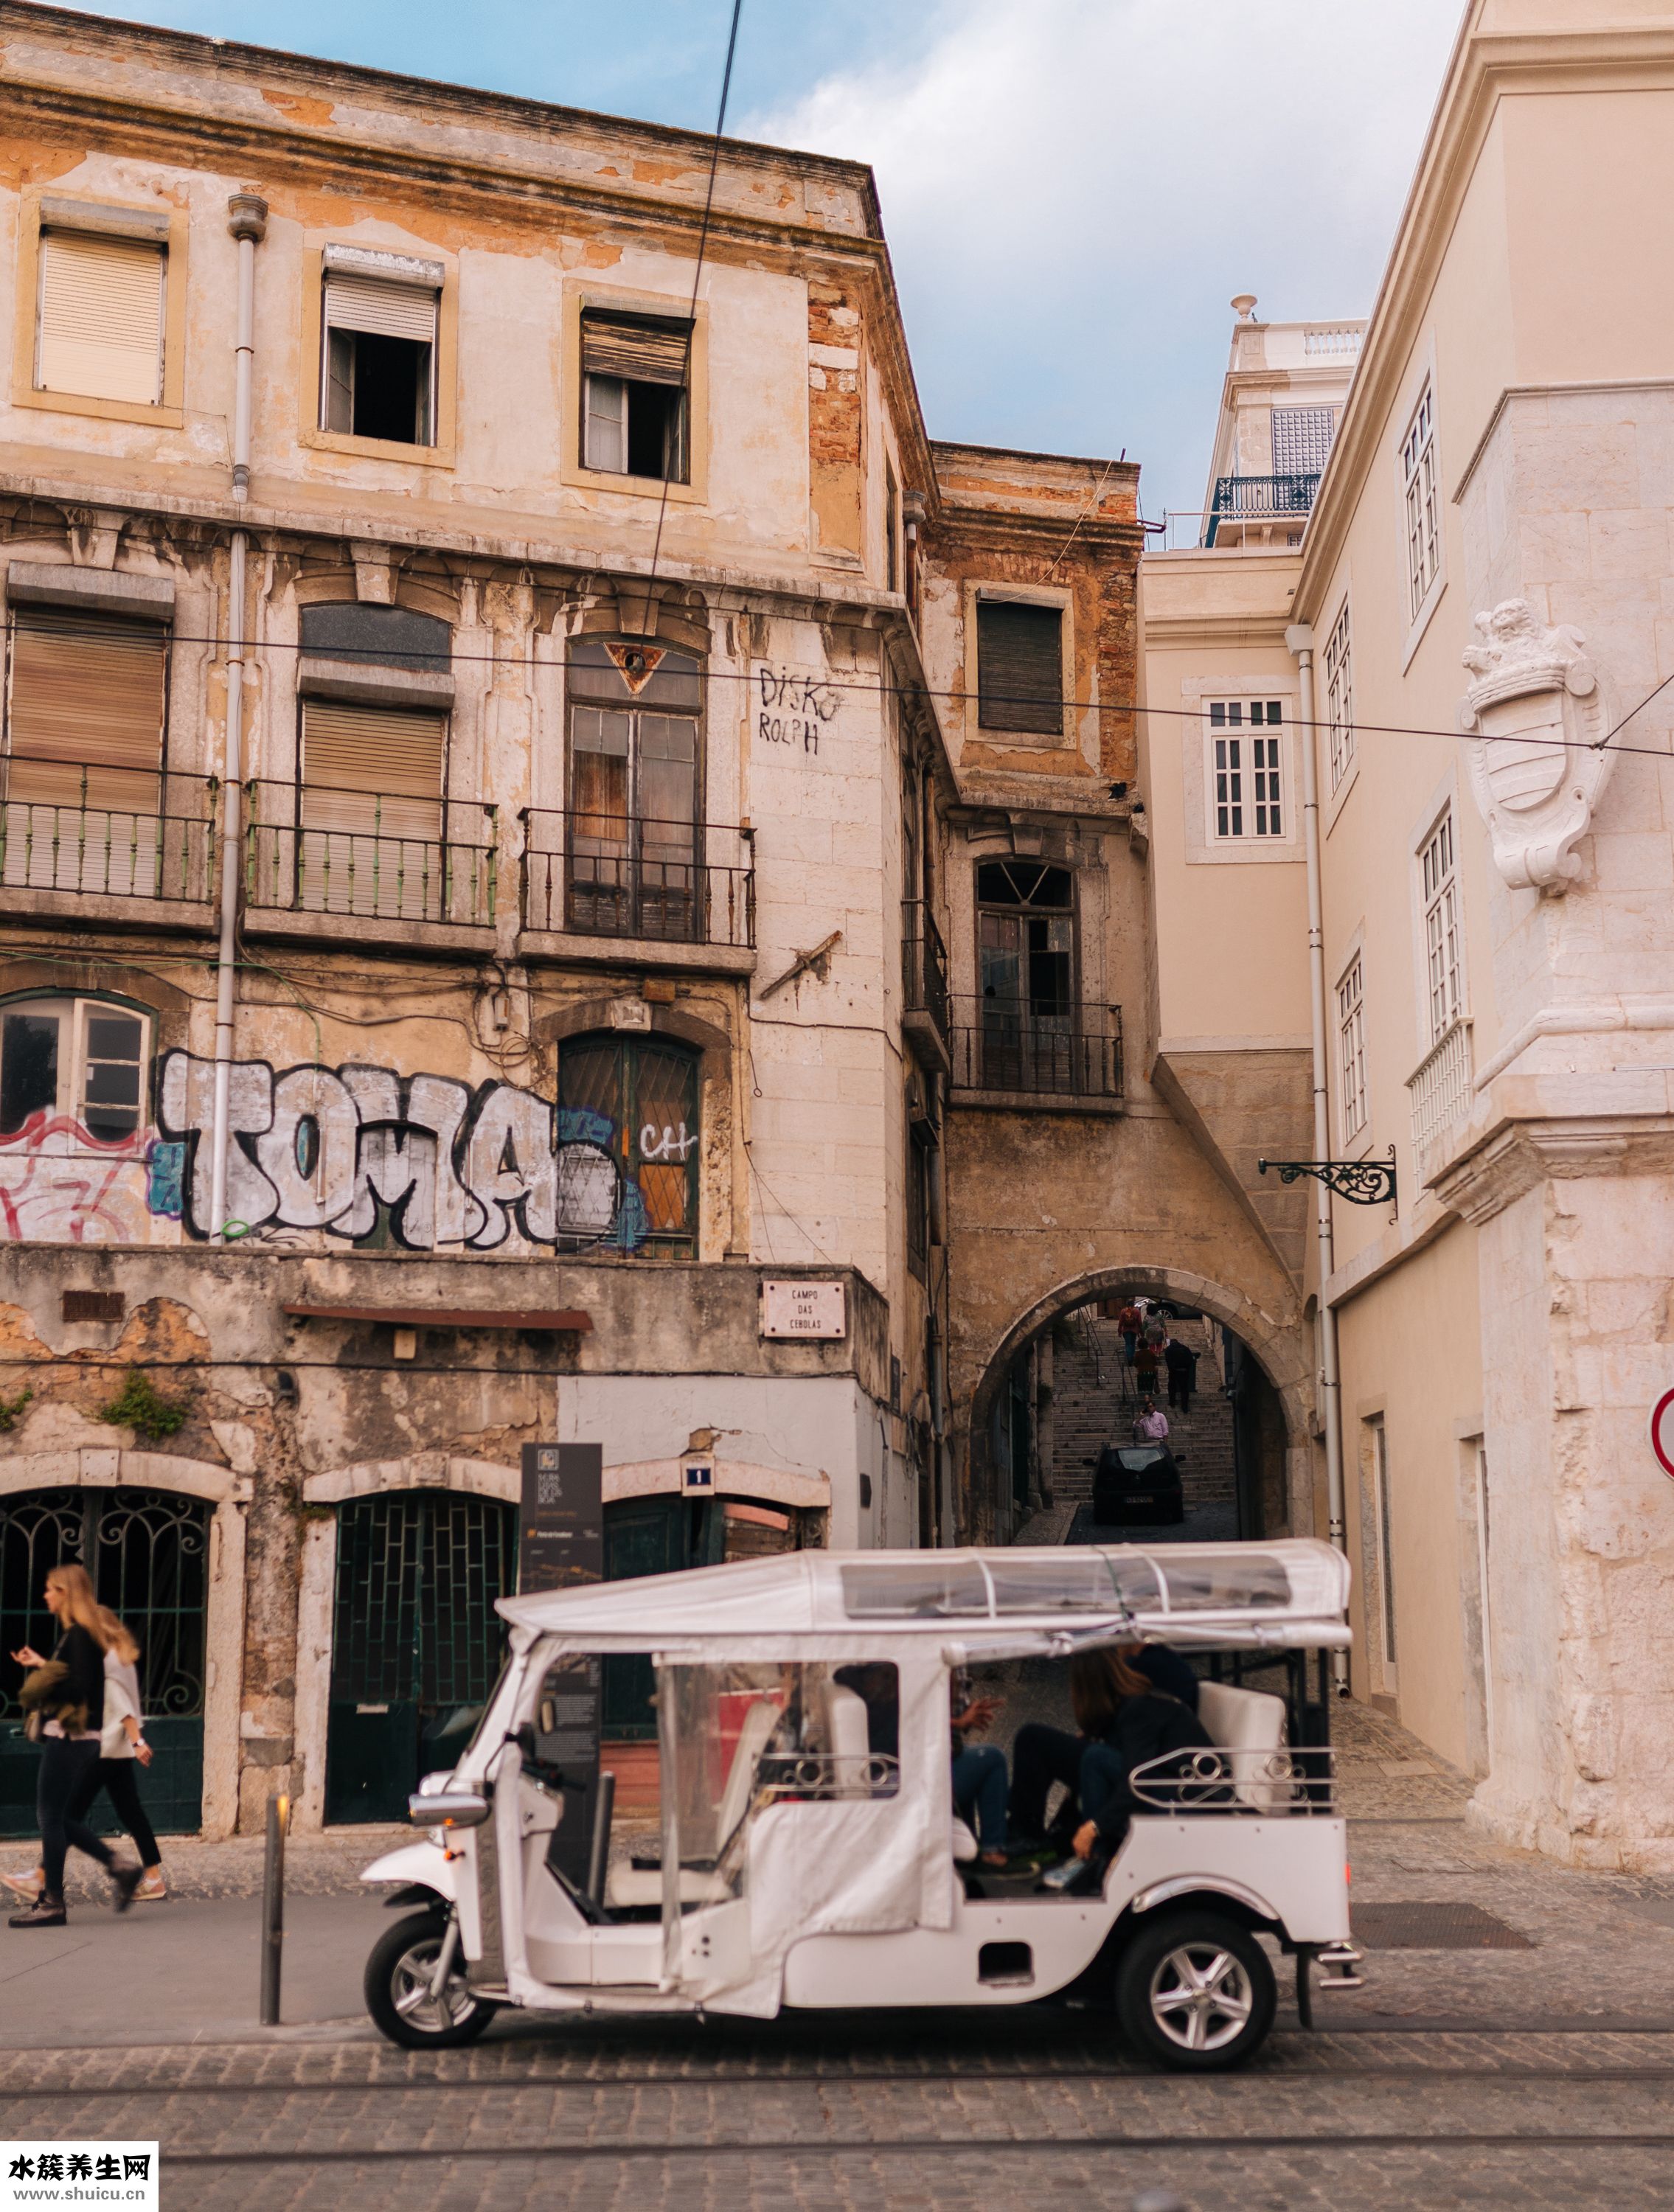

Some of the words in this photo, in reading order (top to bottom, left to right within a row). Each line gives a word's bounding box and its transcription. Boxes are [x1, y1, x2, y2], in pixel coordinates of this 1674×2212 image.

[792, 1290, 818, 1299] CAMPO
[798, 1304, 813, 1314] DAS
[790, 1319, 822, 1329] CEBOLAS
[696, 1470, 702, 1484] 1
